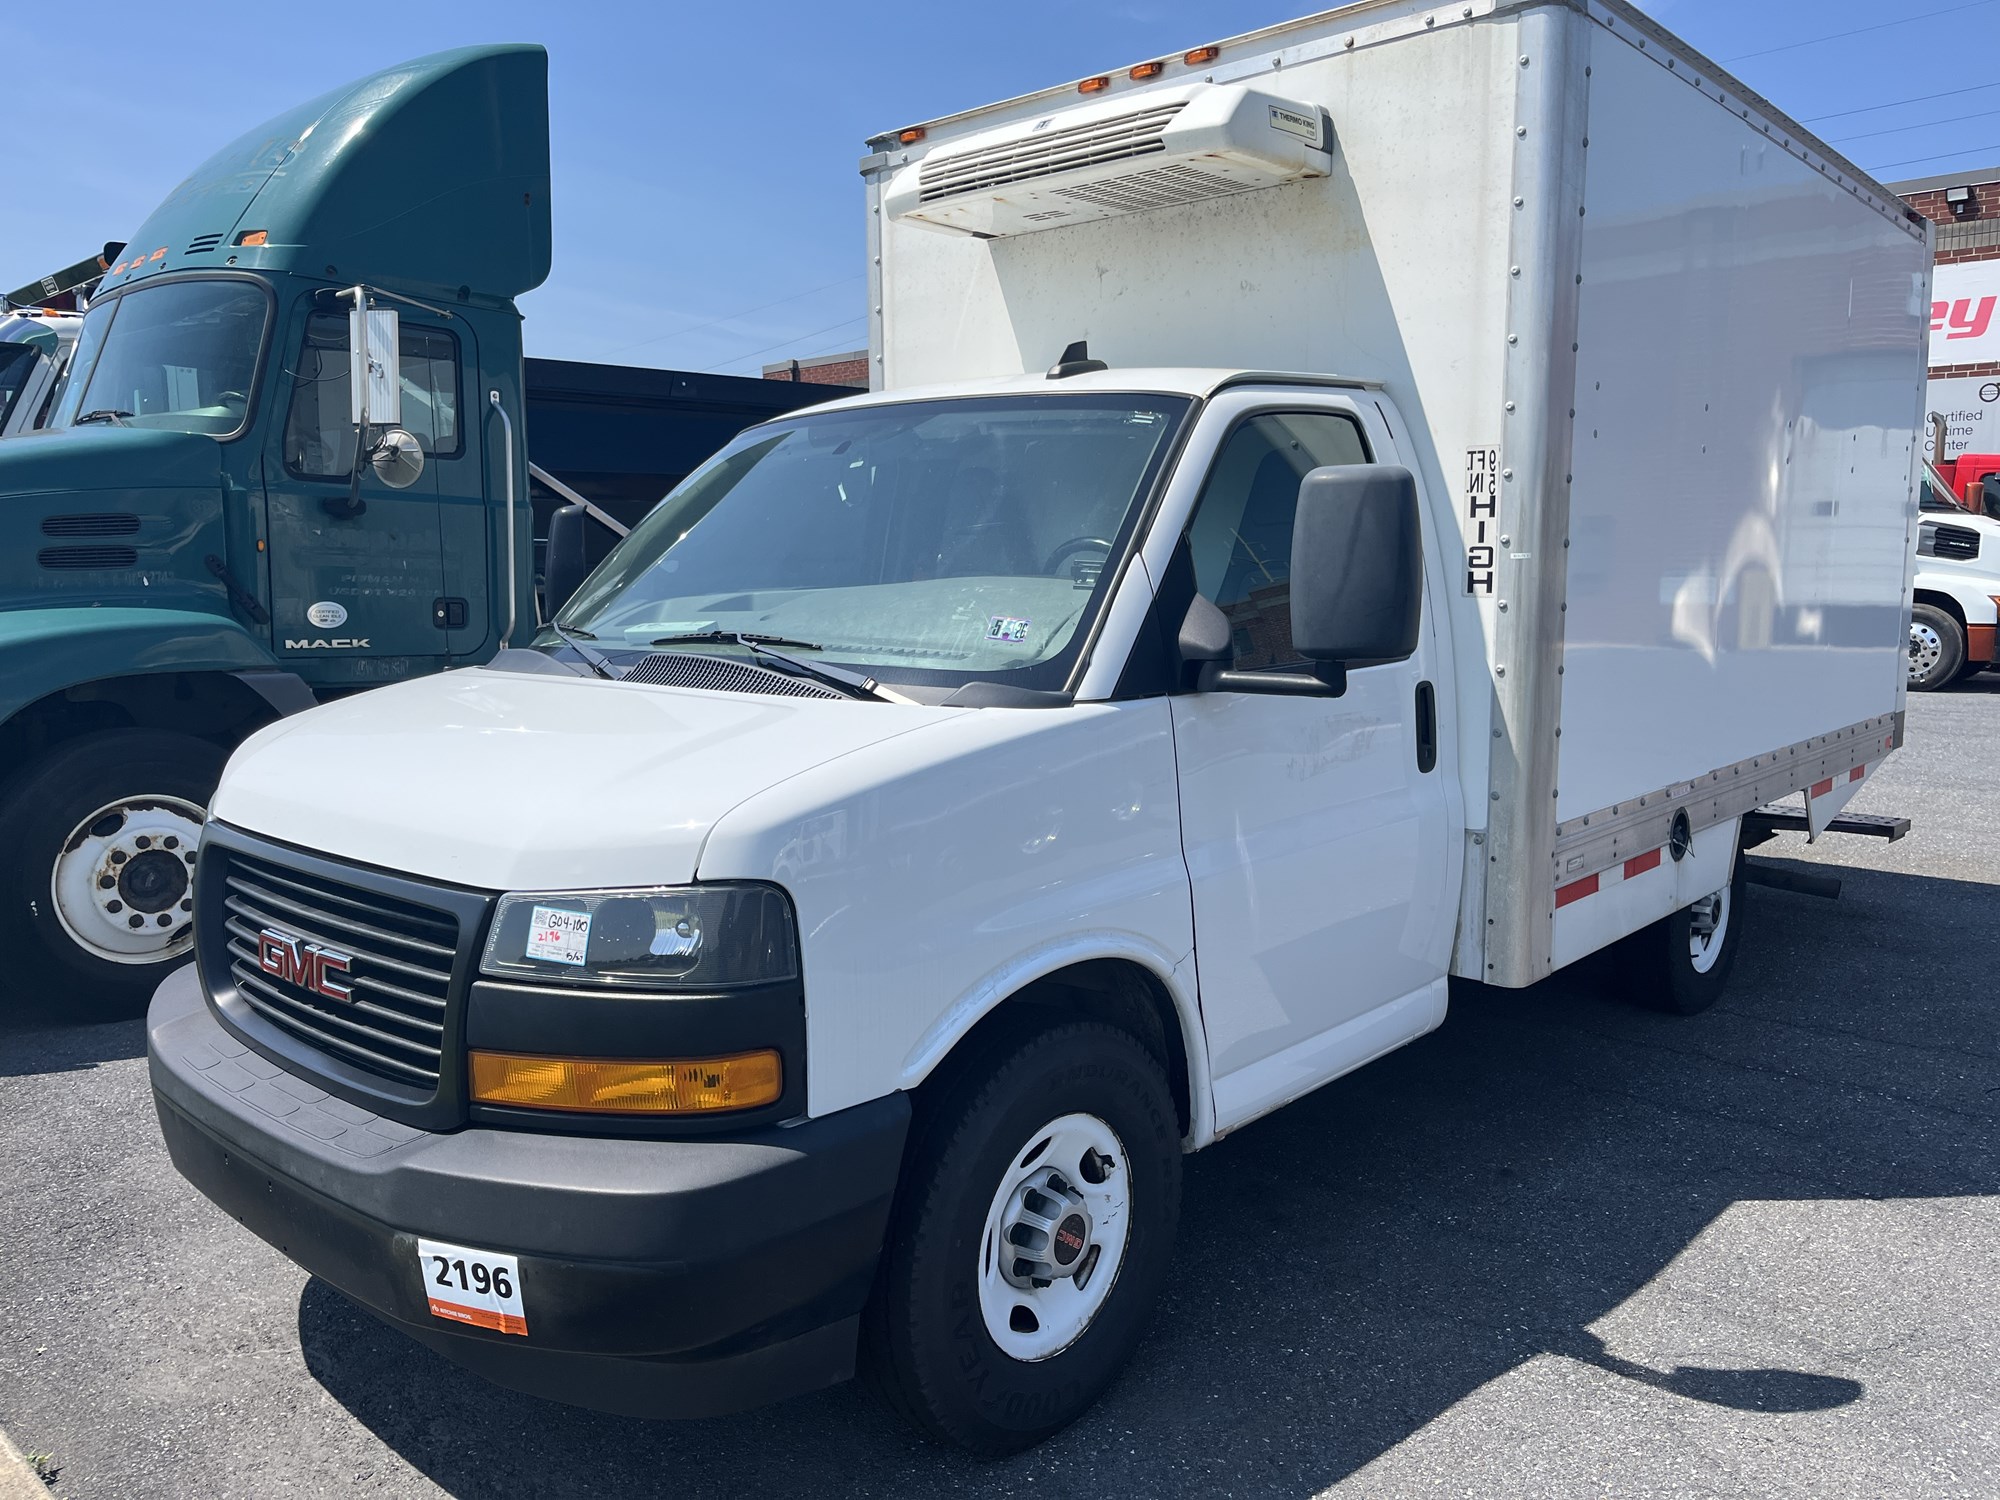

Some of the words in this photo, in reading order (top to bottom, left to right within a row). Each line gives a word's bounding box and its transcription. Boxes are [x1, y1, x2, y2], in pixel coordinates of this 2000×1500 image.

[1279, 112, 1302, 125] THERMO
[1302, 119, 1315, 130] KING
[1926, 410, 1983, 423] Crtified
[1926, 426, 1974, 437] Uime
[1924, 440, 1969, 451] Cnter
[991, 620, 1004, 636] 5
[284, 638, 371, 649] MACK
[538, 931, 560, 942] 2196
[259, 928, 353, 1003] GMC
[1057, 1229, 1083, 1250] GMC
[433, 1255, 513, 1299] 2196
